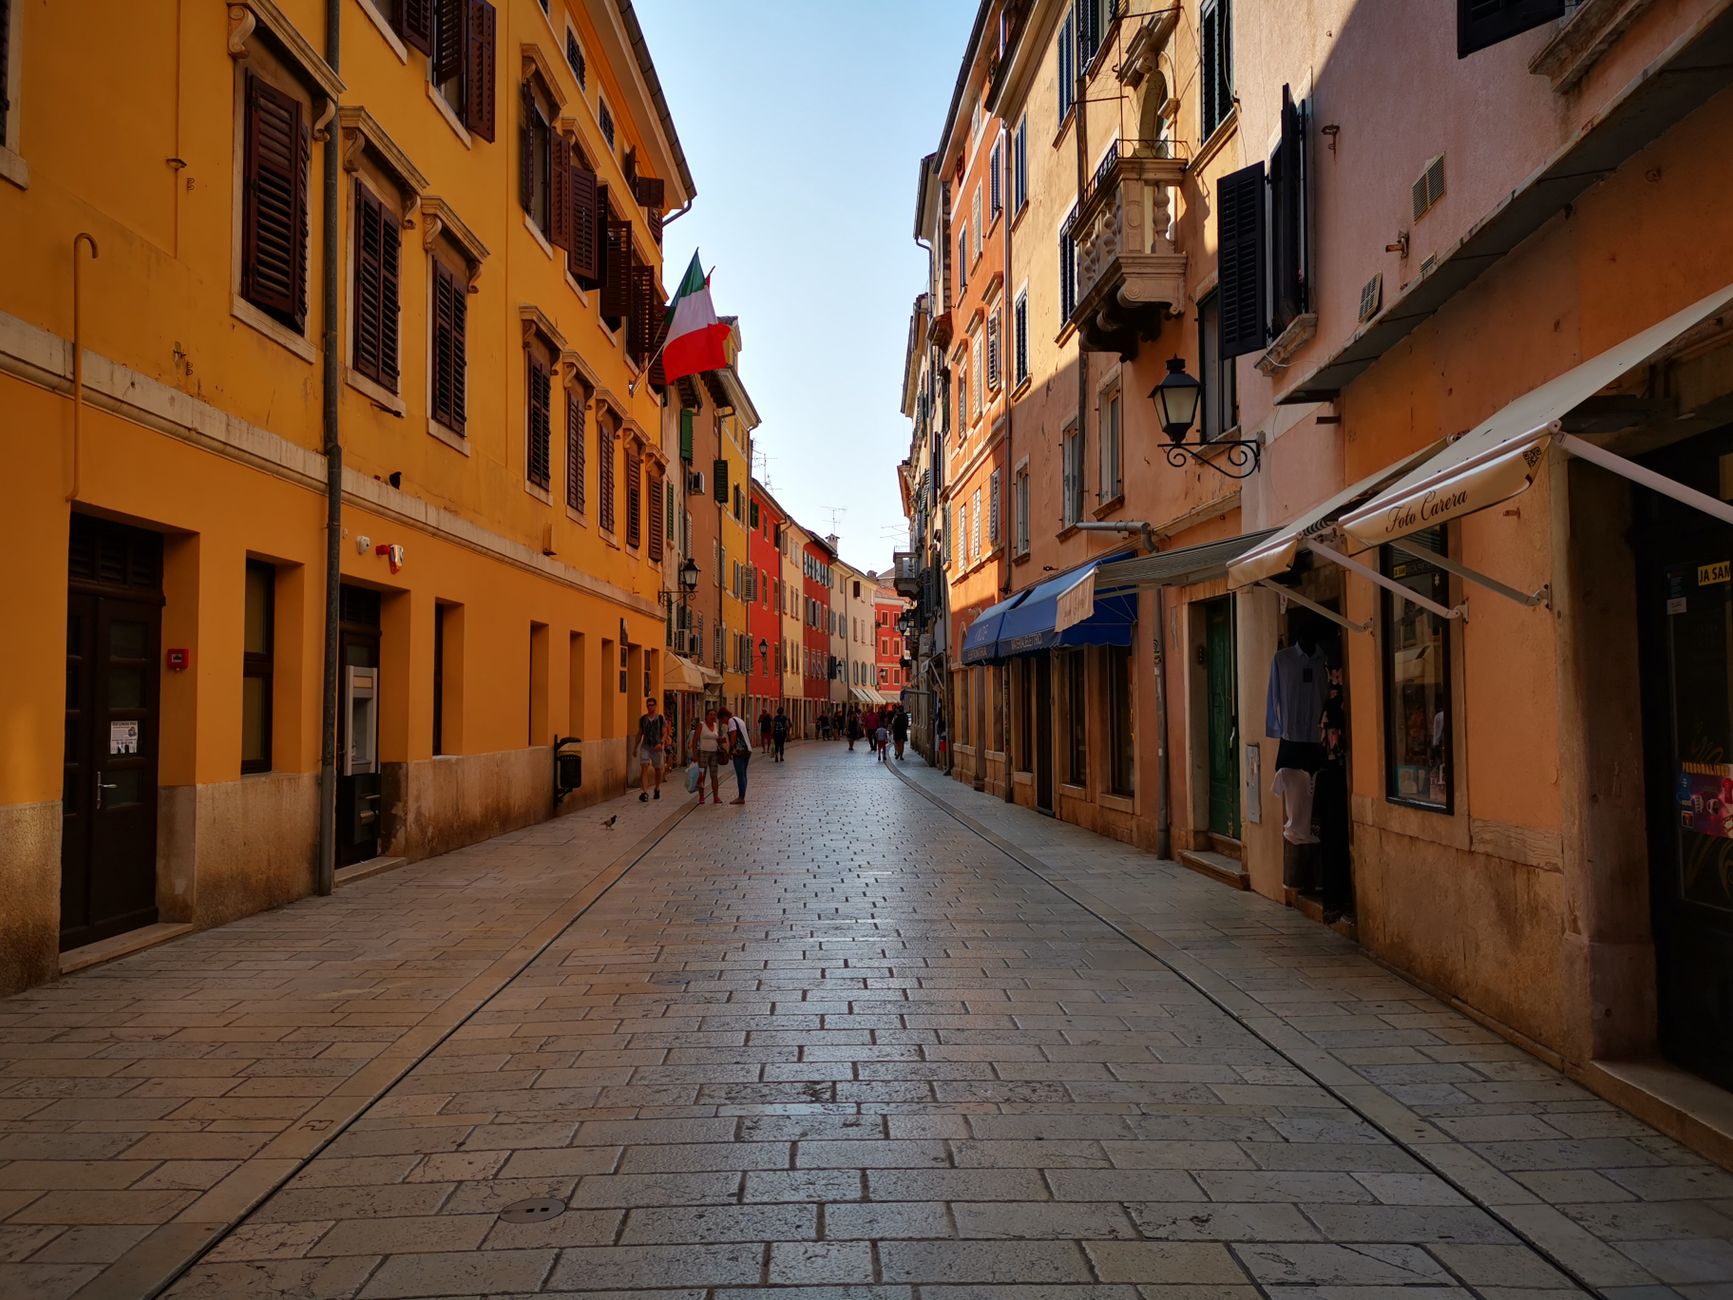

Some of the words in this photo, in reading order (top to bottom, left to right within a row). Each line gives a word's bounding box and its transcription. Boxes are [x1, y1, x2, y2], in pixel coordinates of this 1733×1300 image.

[1386, 506, 1416, 533] Foto
[1421, 490, 1468, 521] Carera
[1699, 568, 1710, 584] JA
